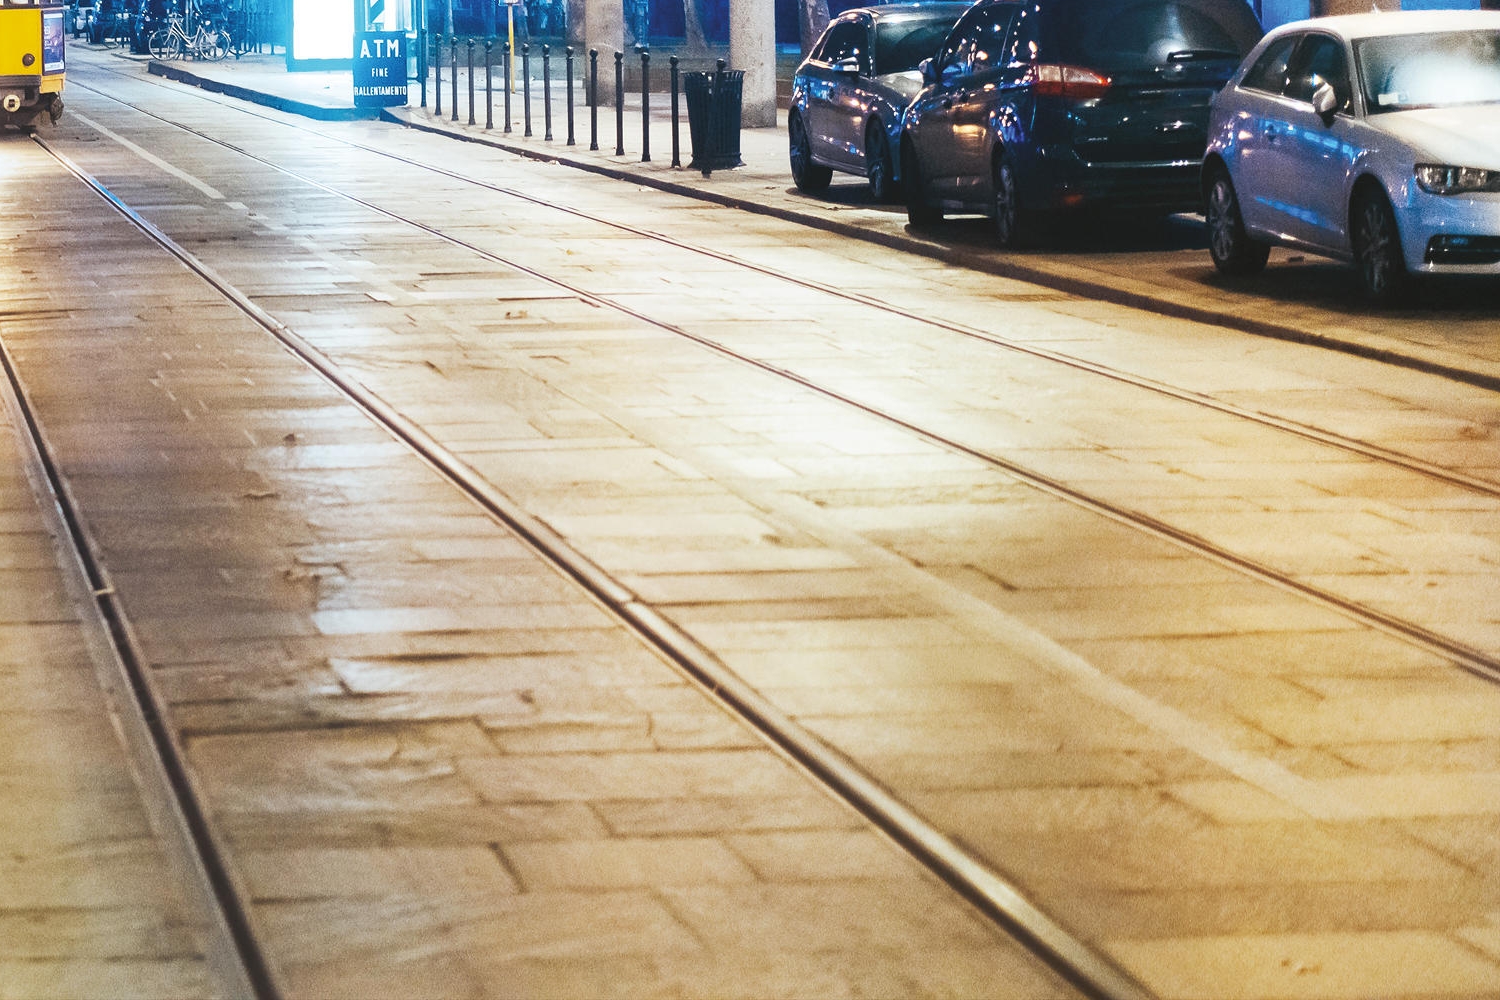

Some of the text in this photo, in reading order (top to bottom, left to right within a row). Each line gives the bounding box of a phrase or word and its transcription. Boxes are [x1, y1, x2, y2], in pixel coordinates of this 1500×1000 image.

[360, 39, 402, 59] A.T.M.
[371, 67, 389, 78] FINE
[354, 86, 407, 97] RALLENTAMENTO
